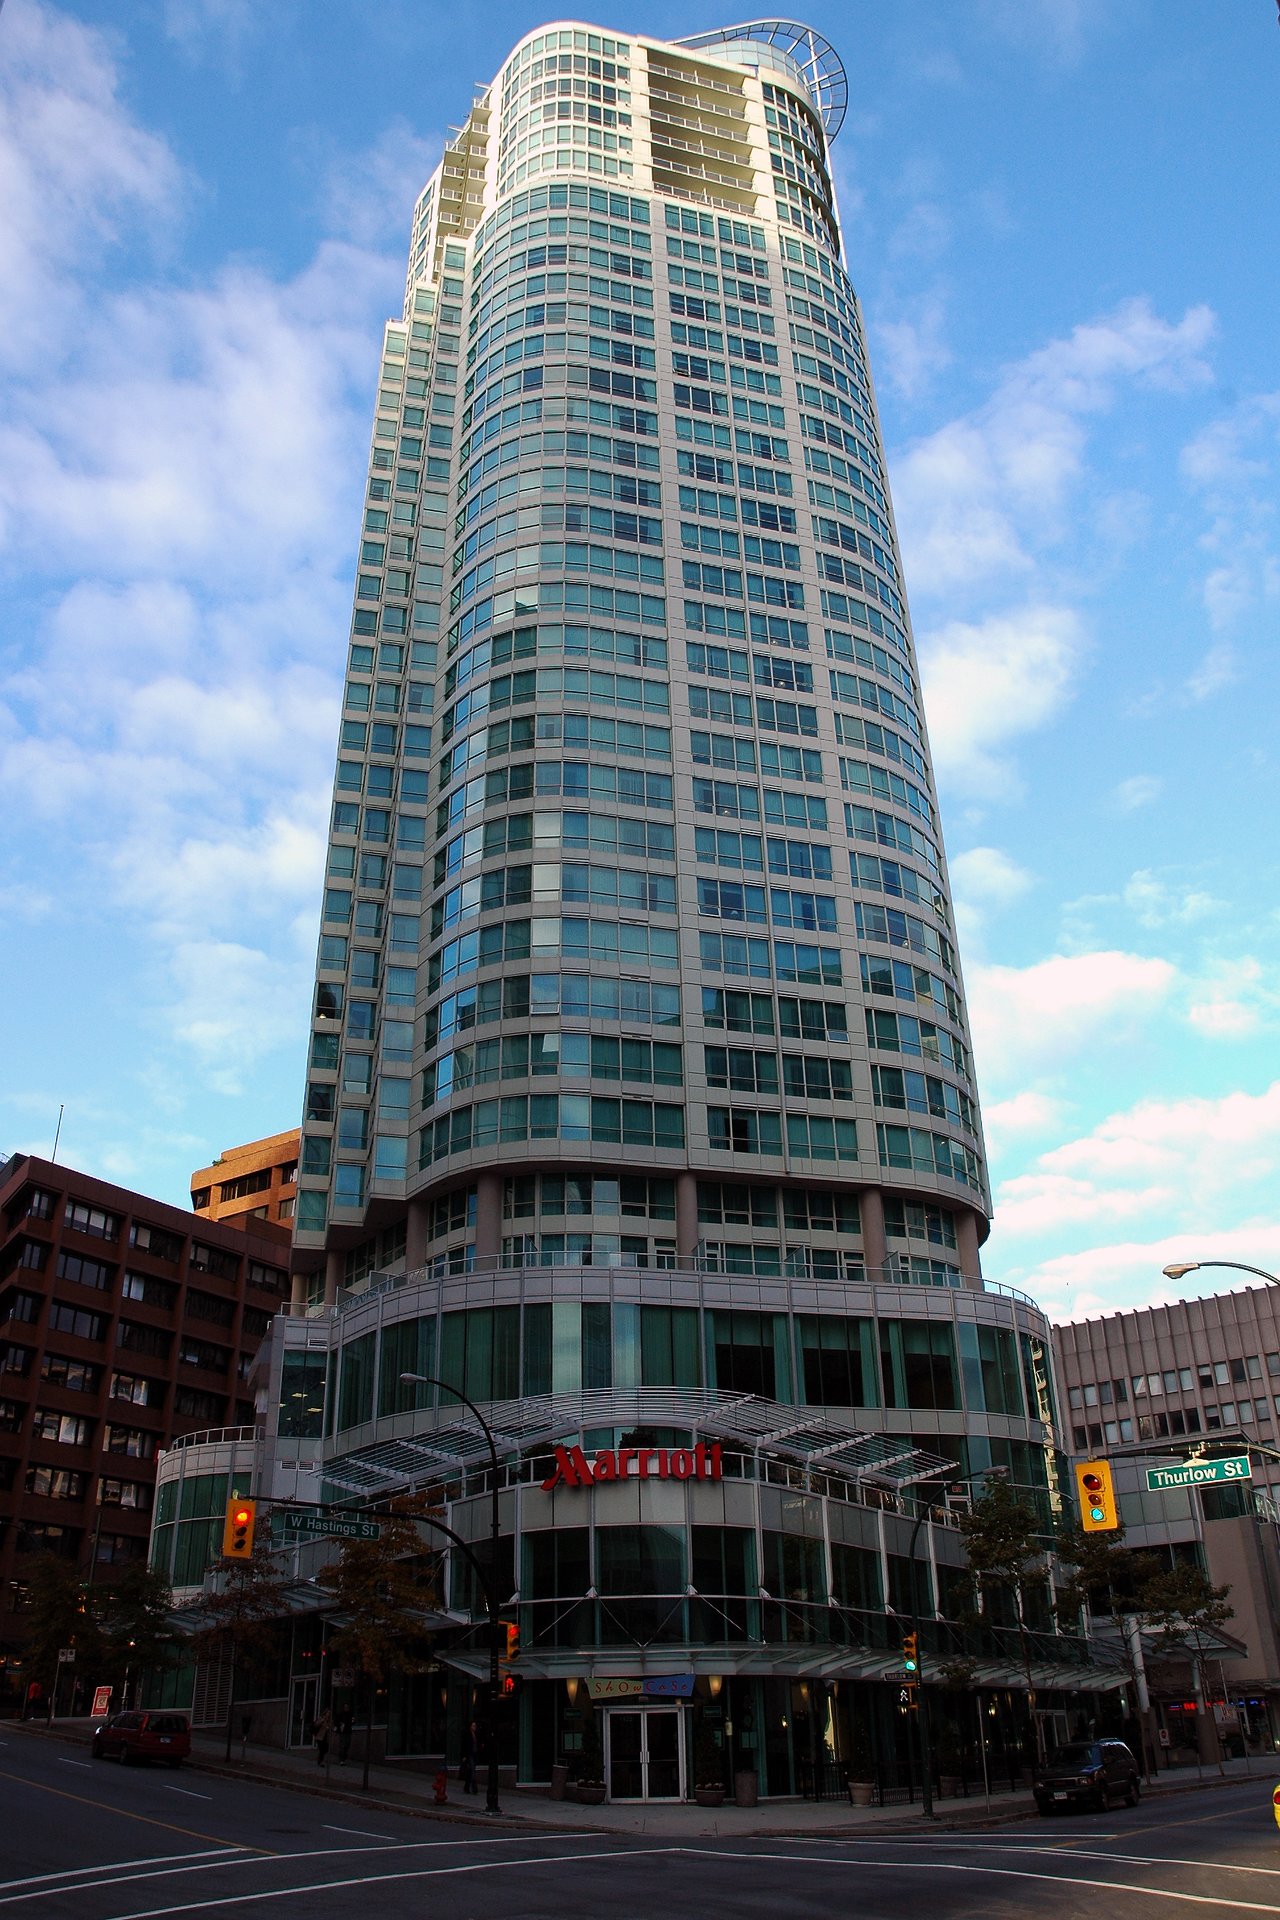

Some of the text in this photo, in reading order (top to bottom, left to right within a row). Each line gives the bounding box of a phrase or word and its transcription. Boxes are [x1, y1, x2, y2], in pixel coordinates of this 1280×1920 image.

[540, 1441, 723, 1491] Marriott
[1153, 1462, 1244, 1486] Thurlow St
[290, 1515, 375, 1536] W Hastings St
